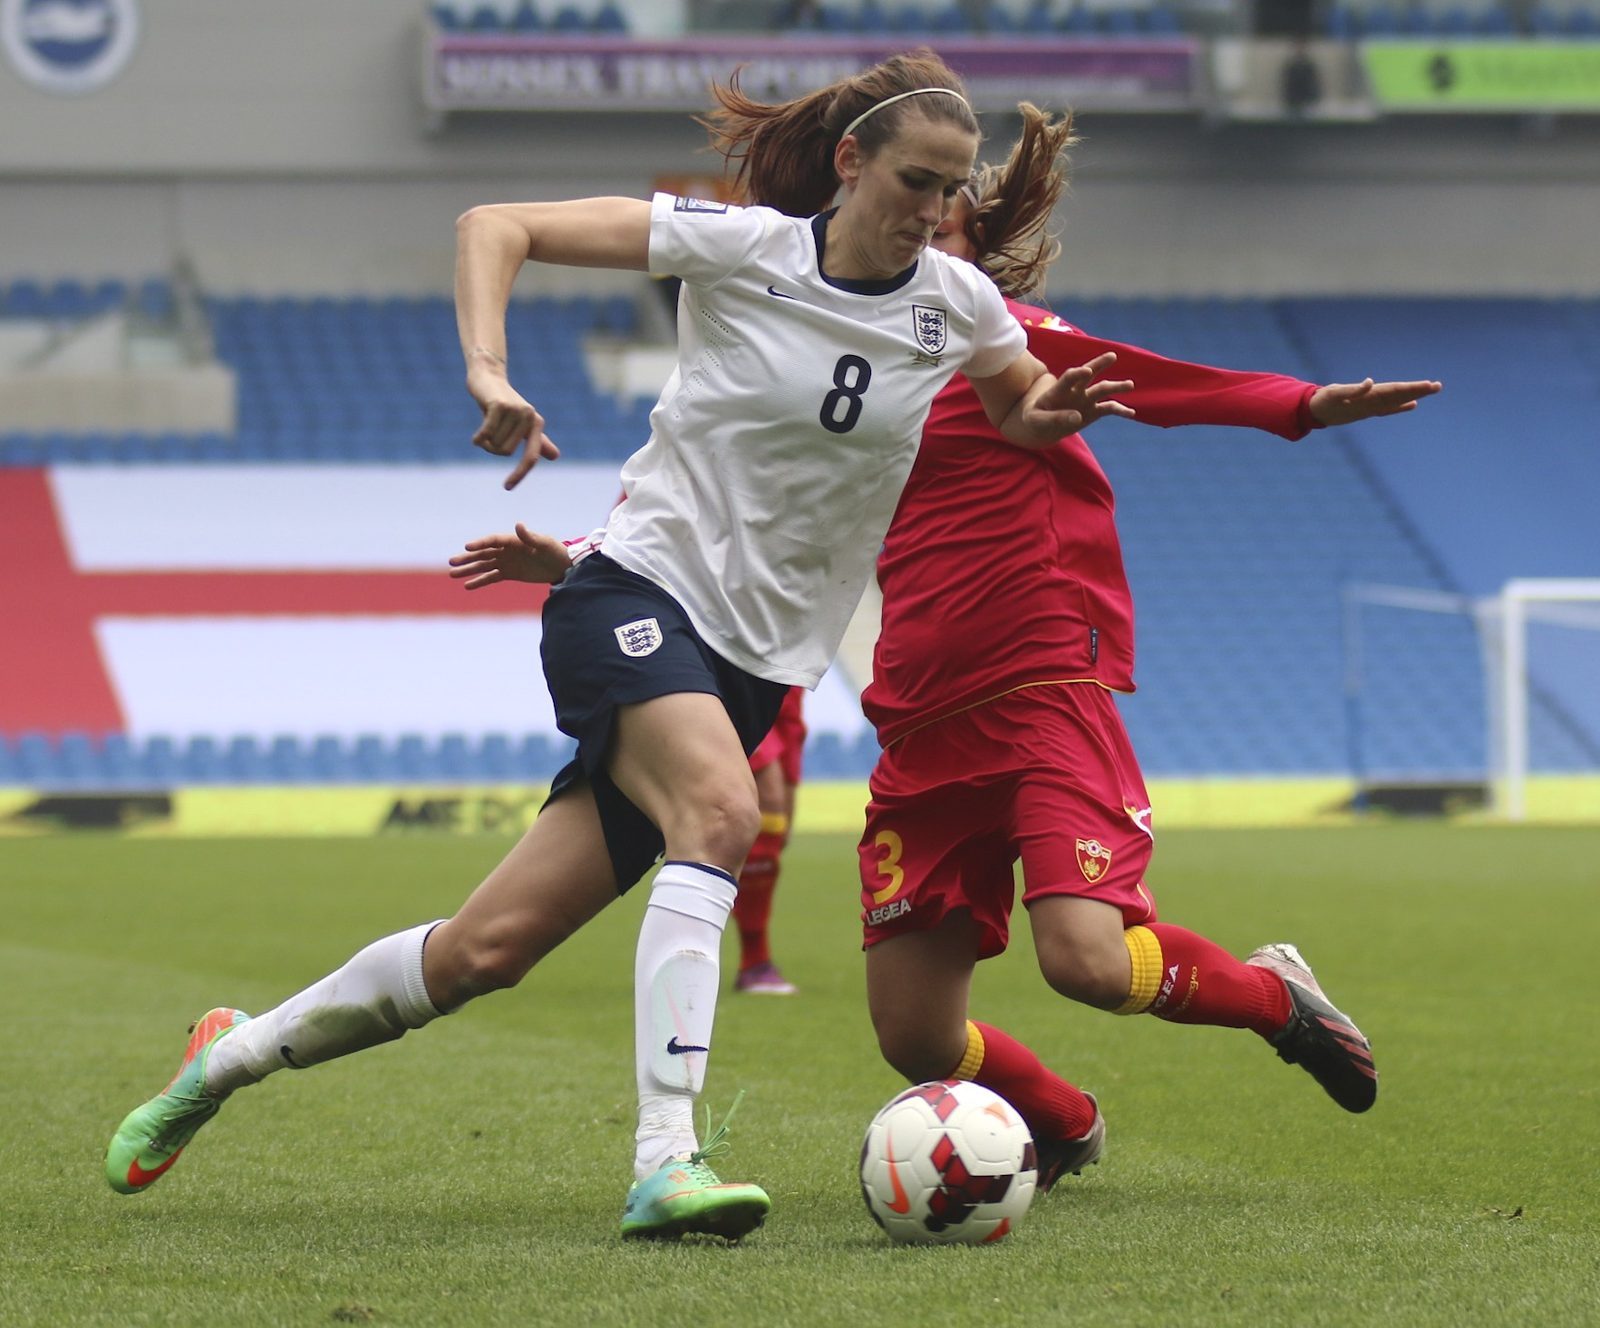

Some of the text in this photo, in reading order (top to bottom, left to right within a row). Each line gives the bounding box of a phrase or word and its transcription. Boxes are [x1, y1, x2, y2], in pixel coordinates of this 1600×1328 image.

[820, 354, 872, 434] 8
[873, 830, 904, 905] 3
[866, 898, 912, 926] LEGEA
